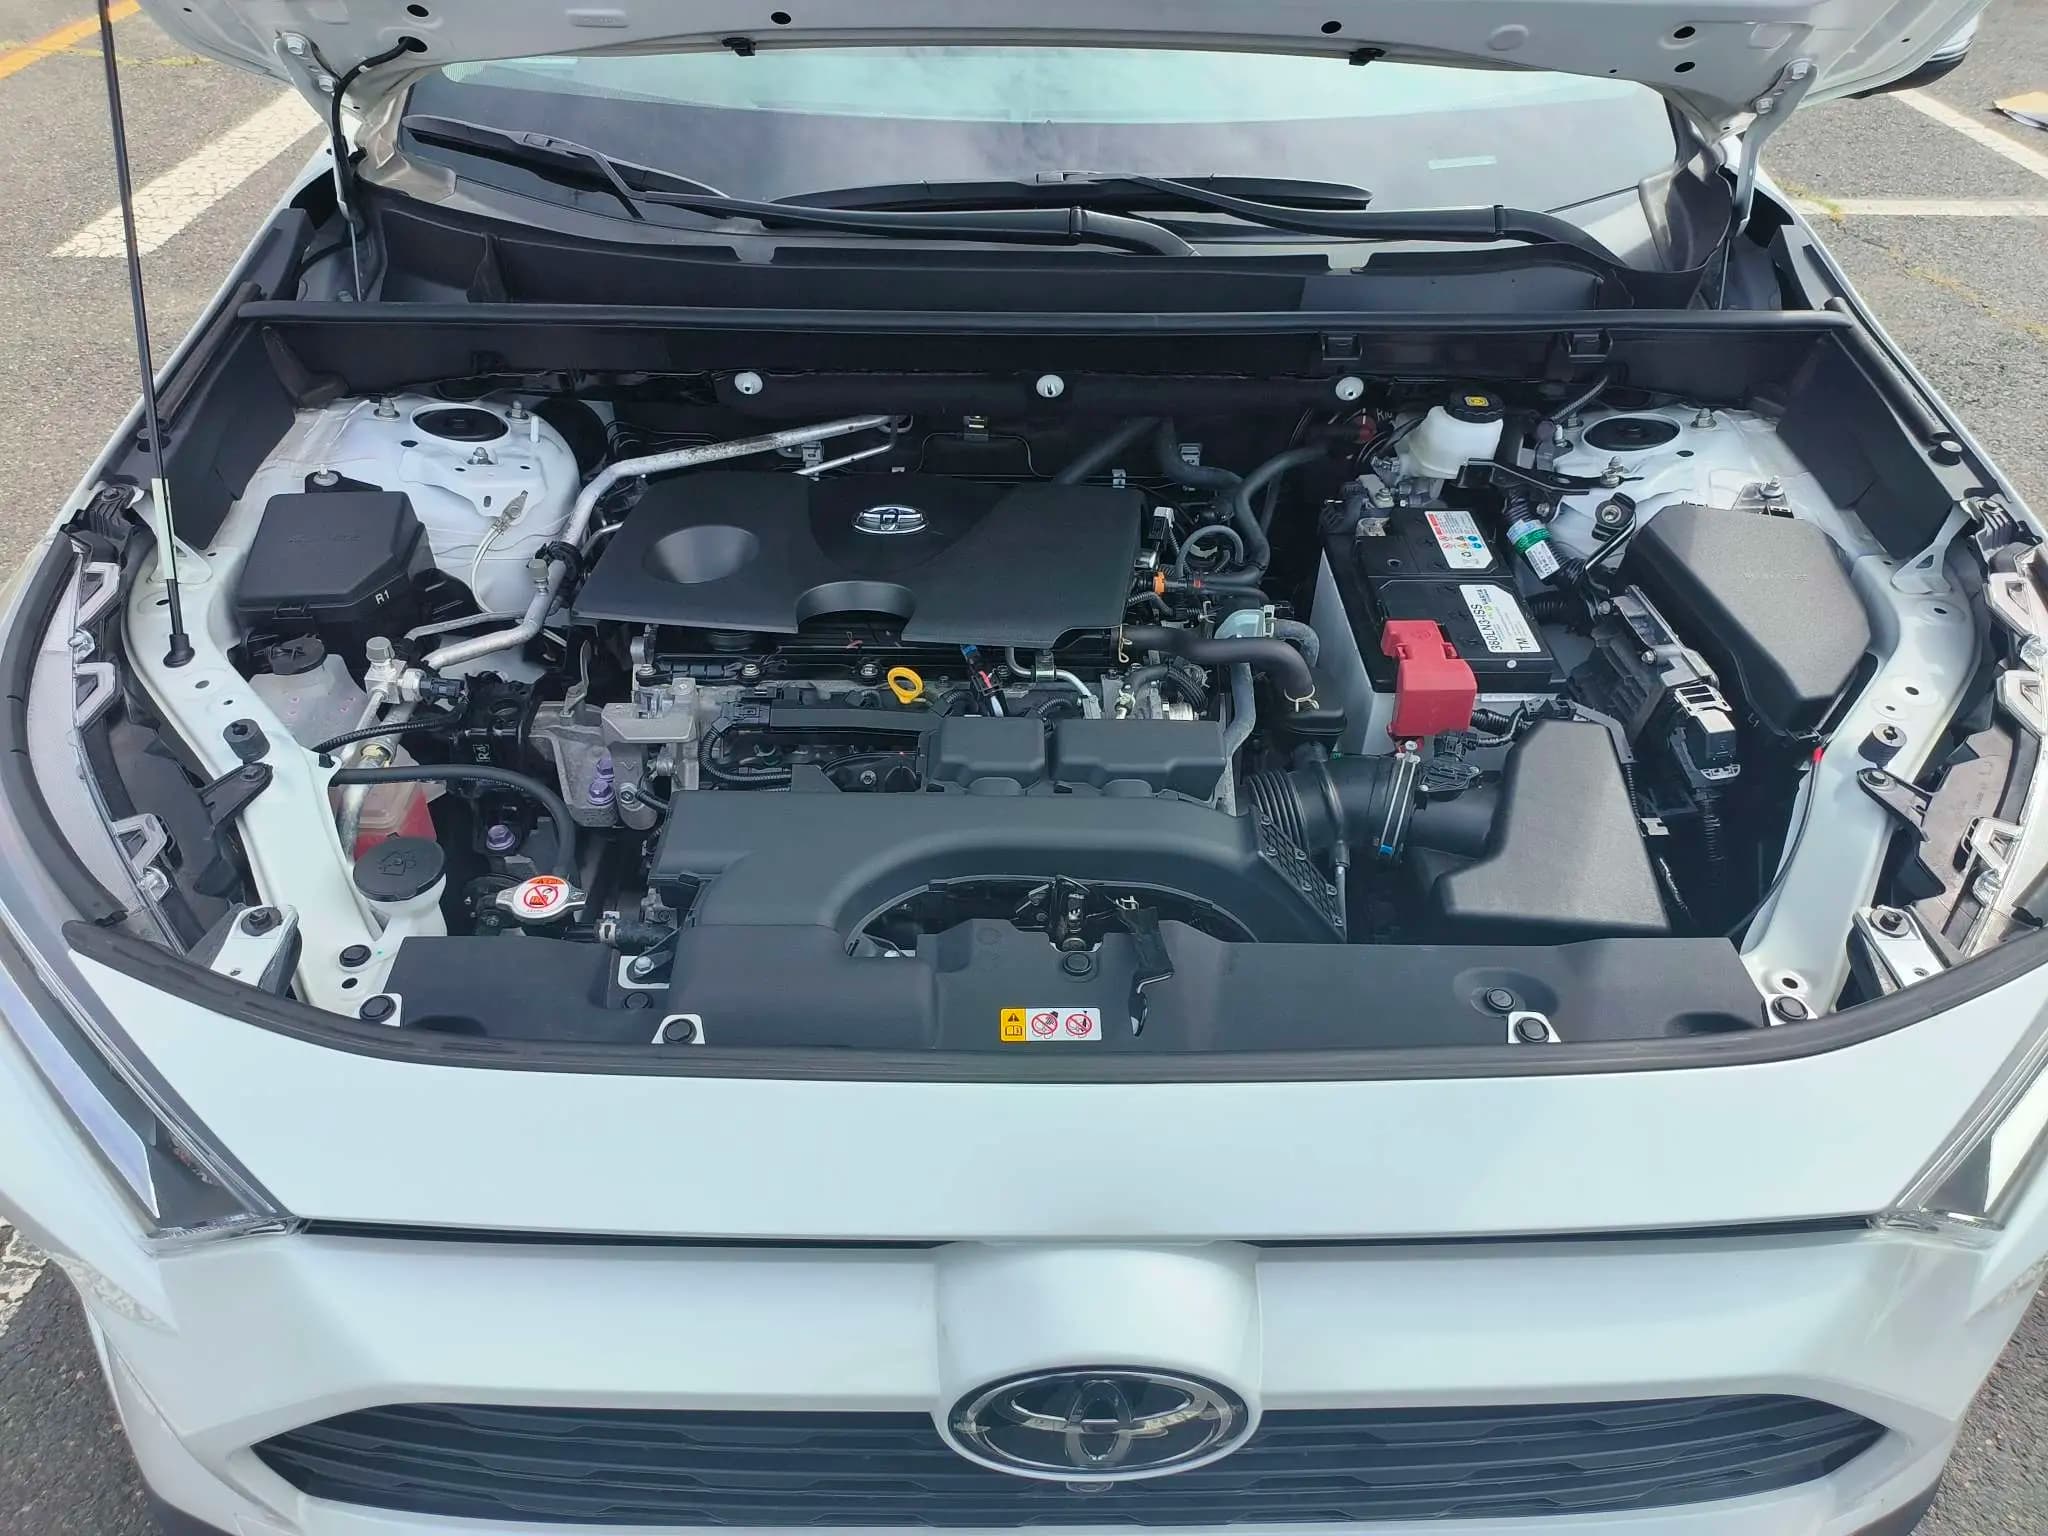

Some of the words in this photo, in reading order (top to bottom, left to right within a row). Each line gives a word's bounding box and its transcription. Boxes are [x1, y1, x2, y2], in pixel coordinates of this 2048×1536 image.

[375, 589, 390, 605] R1
[1470, 603, 1503, 651] 380LN3-ISS
[1515, 638, 1531, 651] TM
